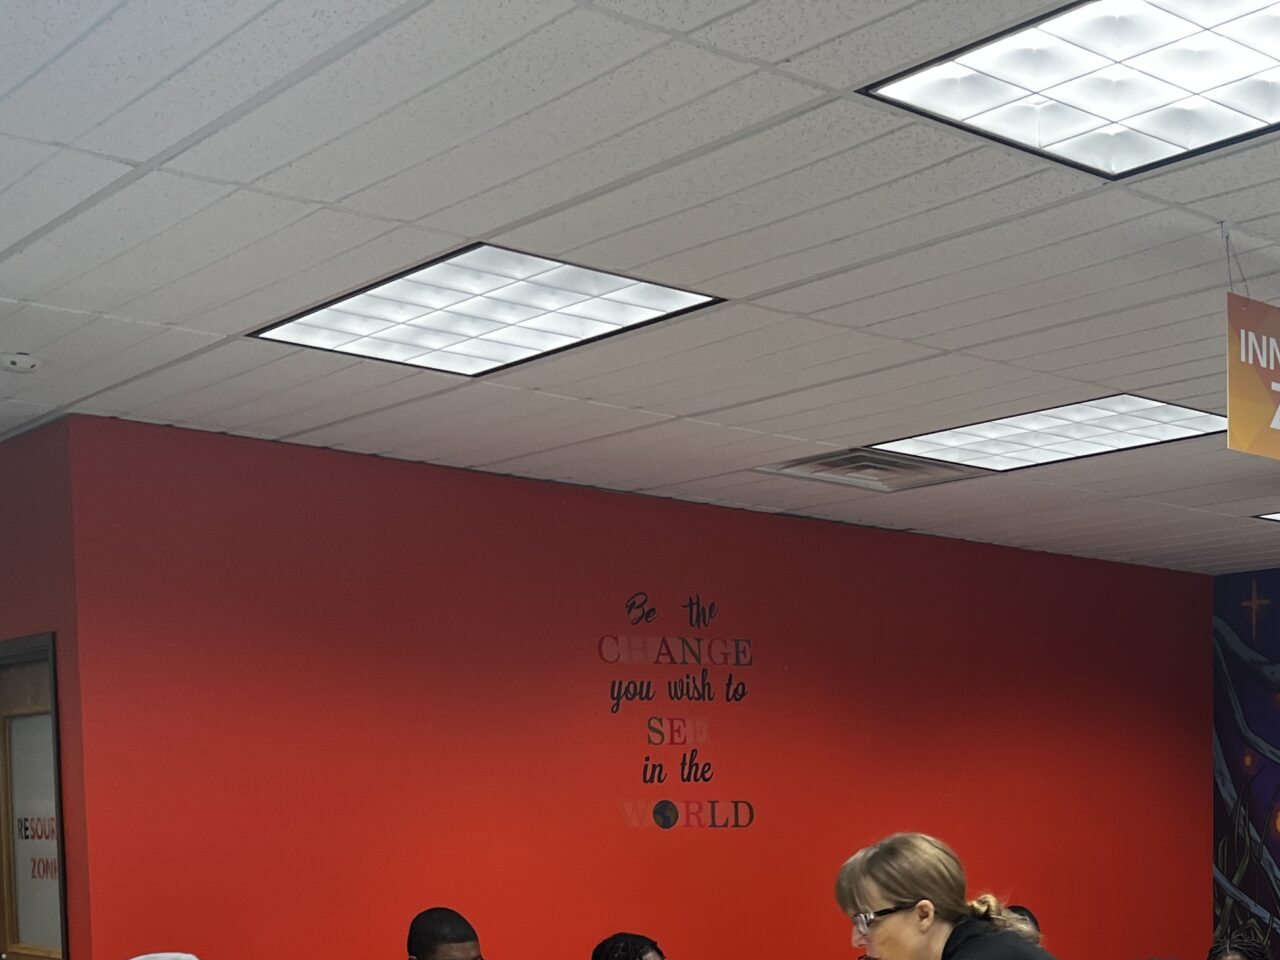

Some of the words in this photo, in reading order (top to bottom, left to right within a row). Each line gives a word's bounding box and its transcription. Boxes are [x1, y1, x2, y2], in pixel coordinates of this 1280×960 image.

[625, 592, 657, 625] Be
[682, 594, 718, 628] the
[598, 634, 753, 667] CHANGE
[610, 678, 655, 714] you
[667, 668, 715, 702] wish
[725, 673, 748, 702] to
[647, 716, 709, 745] SEE
[643, 756, 667, 784] in
[680, 749, 714, 782] the
[31, 858, 58, 879] ZON
